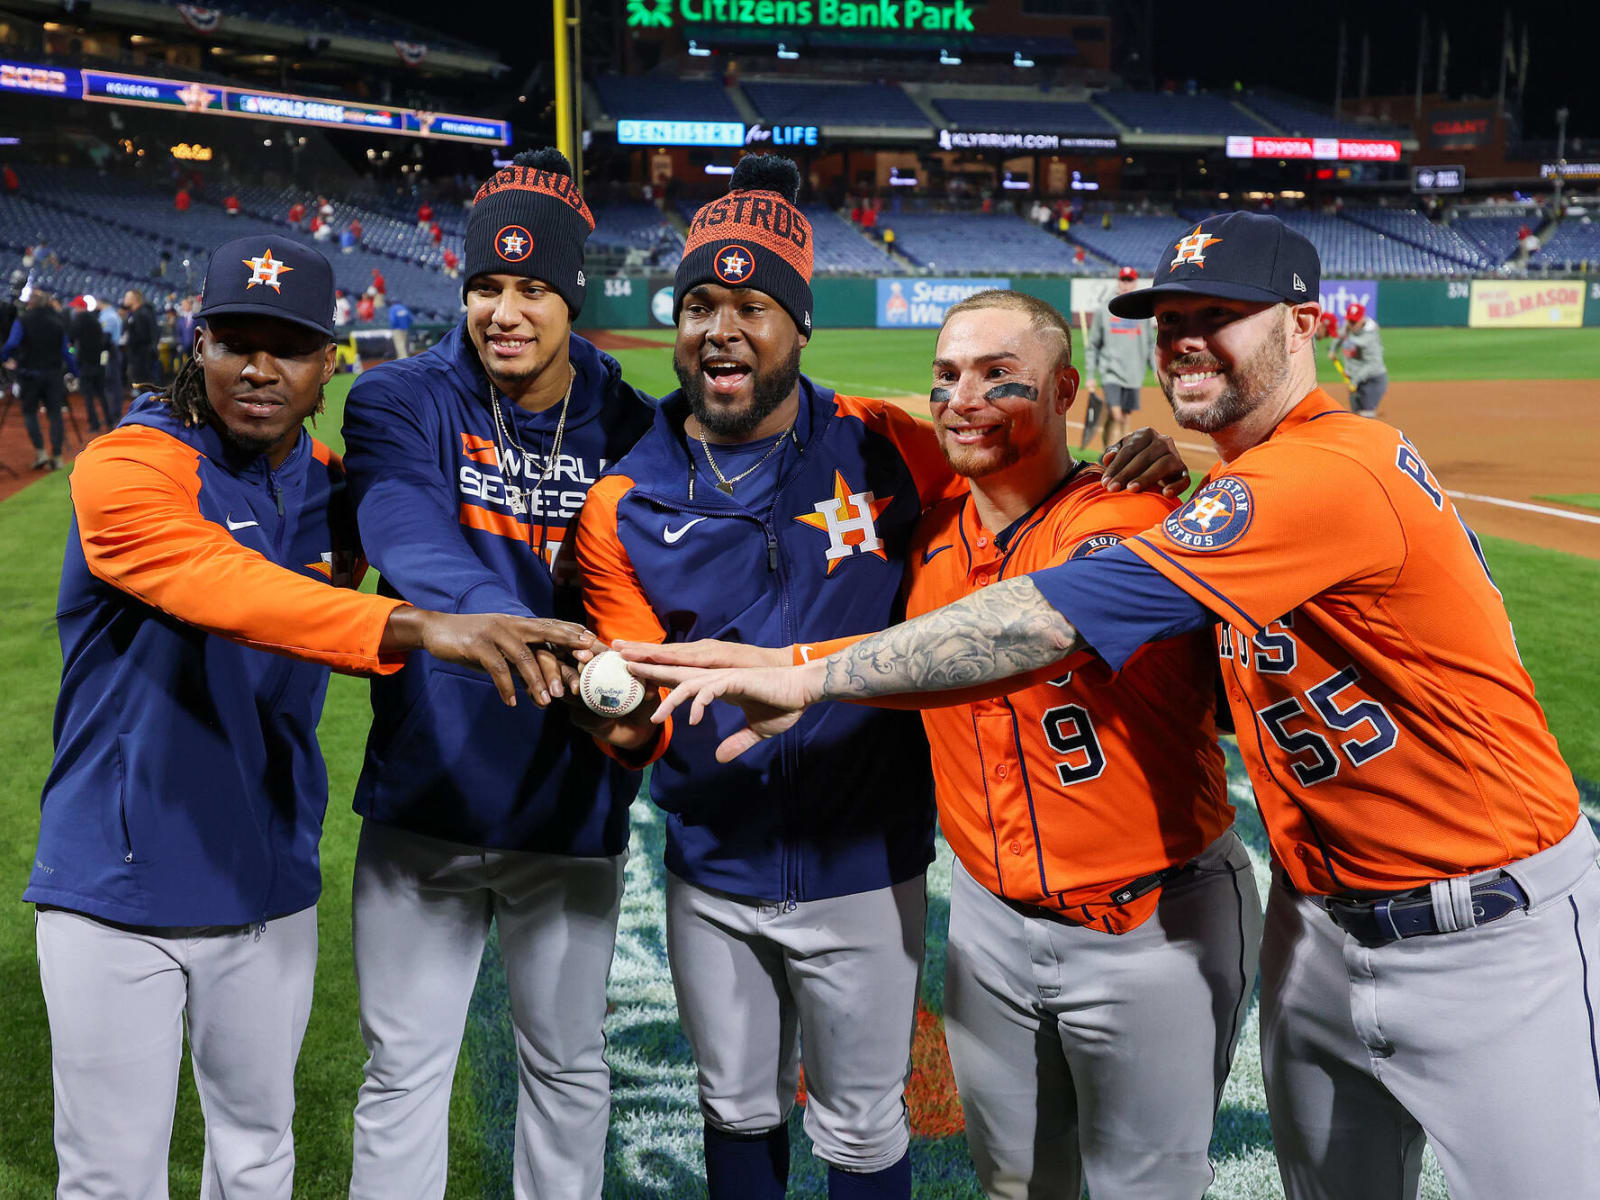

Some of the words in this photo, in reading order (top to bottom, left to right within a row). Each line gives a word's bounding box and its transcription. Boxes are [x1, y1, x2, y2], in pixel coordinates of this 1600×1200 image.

[679, 0, 812, 25] Citizens
[818, 0, 899, 27] Bank
[904, 1, 974, 32] Park
[0, 65, 67, 92] 2022
[257, 97, 304, 117] WORLD
[305, 102, 344, 122] SERIES
[621, 122, 737, 142] DENTISTRY
[745, 124, 771, 144] for
[772, 126, 818, 145] LIFE
[1255, 141, 1312, 154] TOYOTA
[1340, 144, 1397, 158] TOYOTA
[477, 165, 584, 210] ASTROS
[692, 197, 807, 249] ASTROS
[459, 466, 587, 518] SERIES
[1166, 518, 1214, 547] ASTROS
[1256, 664, 1399, 788] 55
[1041, 703, 1107, 787] 9
